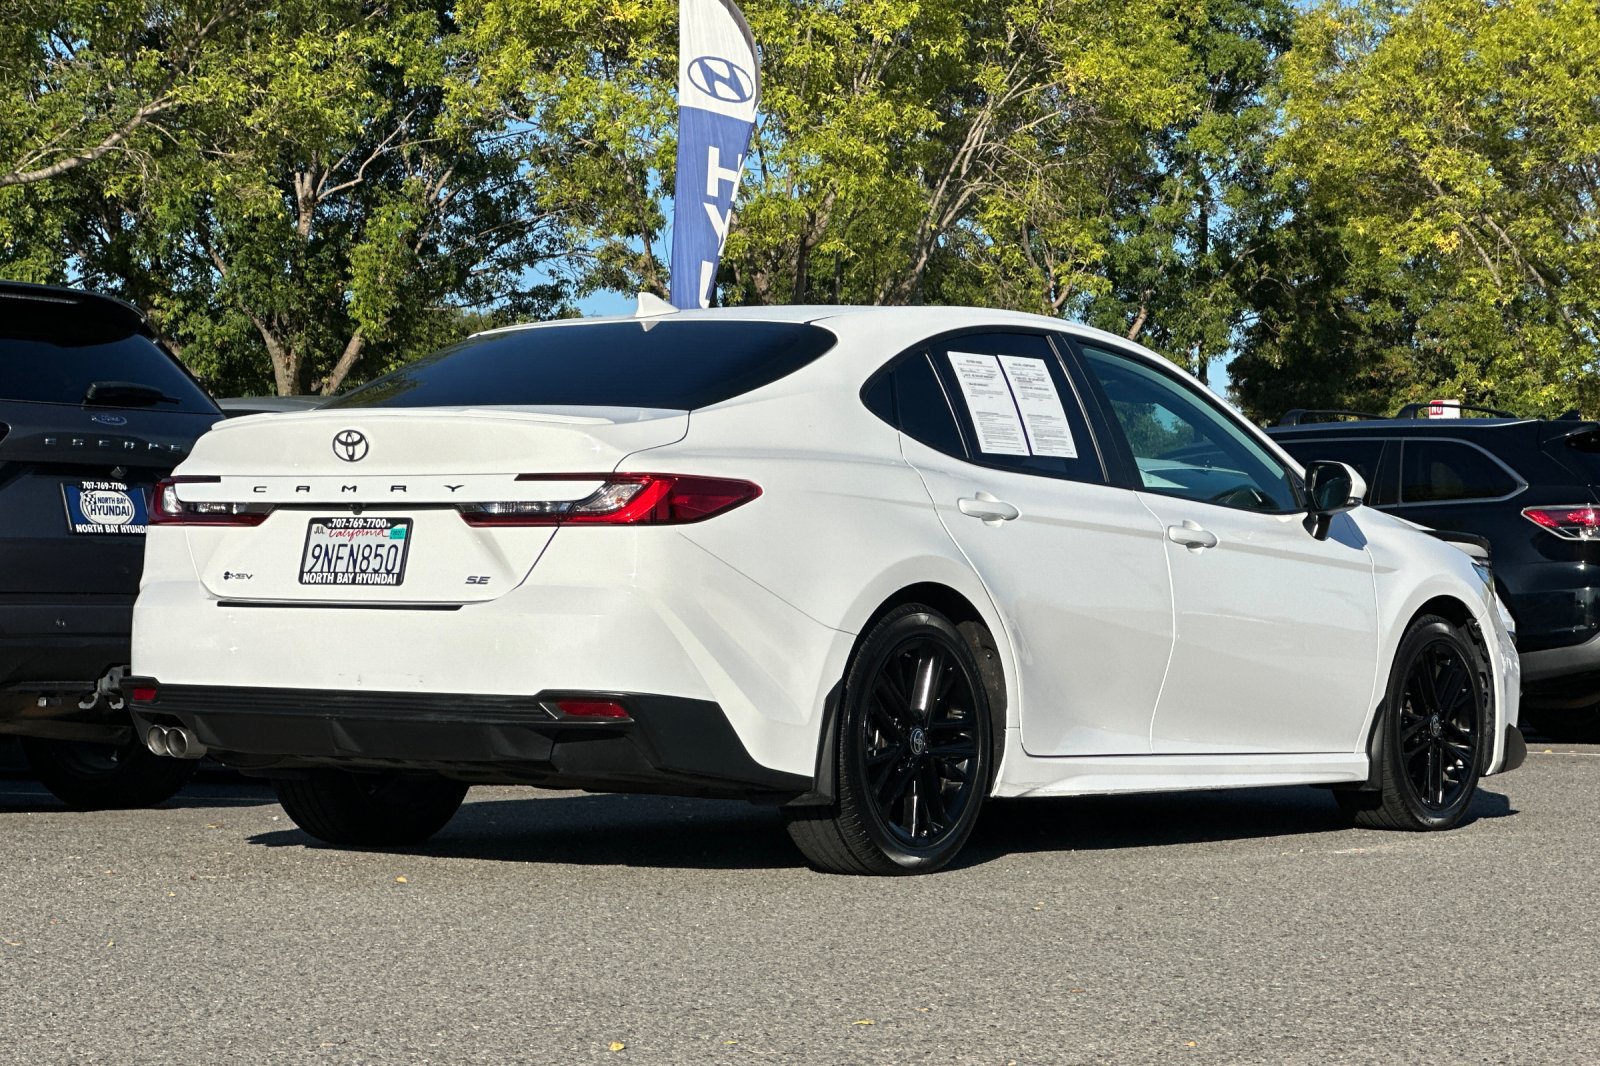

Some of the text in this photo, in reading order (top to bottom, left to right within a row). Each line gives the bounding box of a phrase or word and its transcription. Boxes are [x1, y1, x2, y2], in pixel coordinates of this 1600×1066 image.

[45, 437, 181, 451] ESCAPE
[82, 481, 127, 491] 707-769-7700
[253, 484, 464, 493] CAMRY
[91, 505, 130, 517] HYUNDAI
[331, 518, 387, 528] 707-769-7700
[76, 524, 104, 533] NORTH
[105, 524, 118, 533] BAY
[308, 544, 399, 573] 9NFN850
[302, 573, 398, 584] NORTH BAY HYUNDAI
[465, 575, 491, 585] SE
